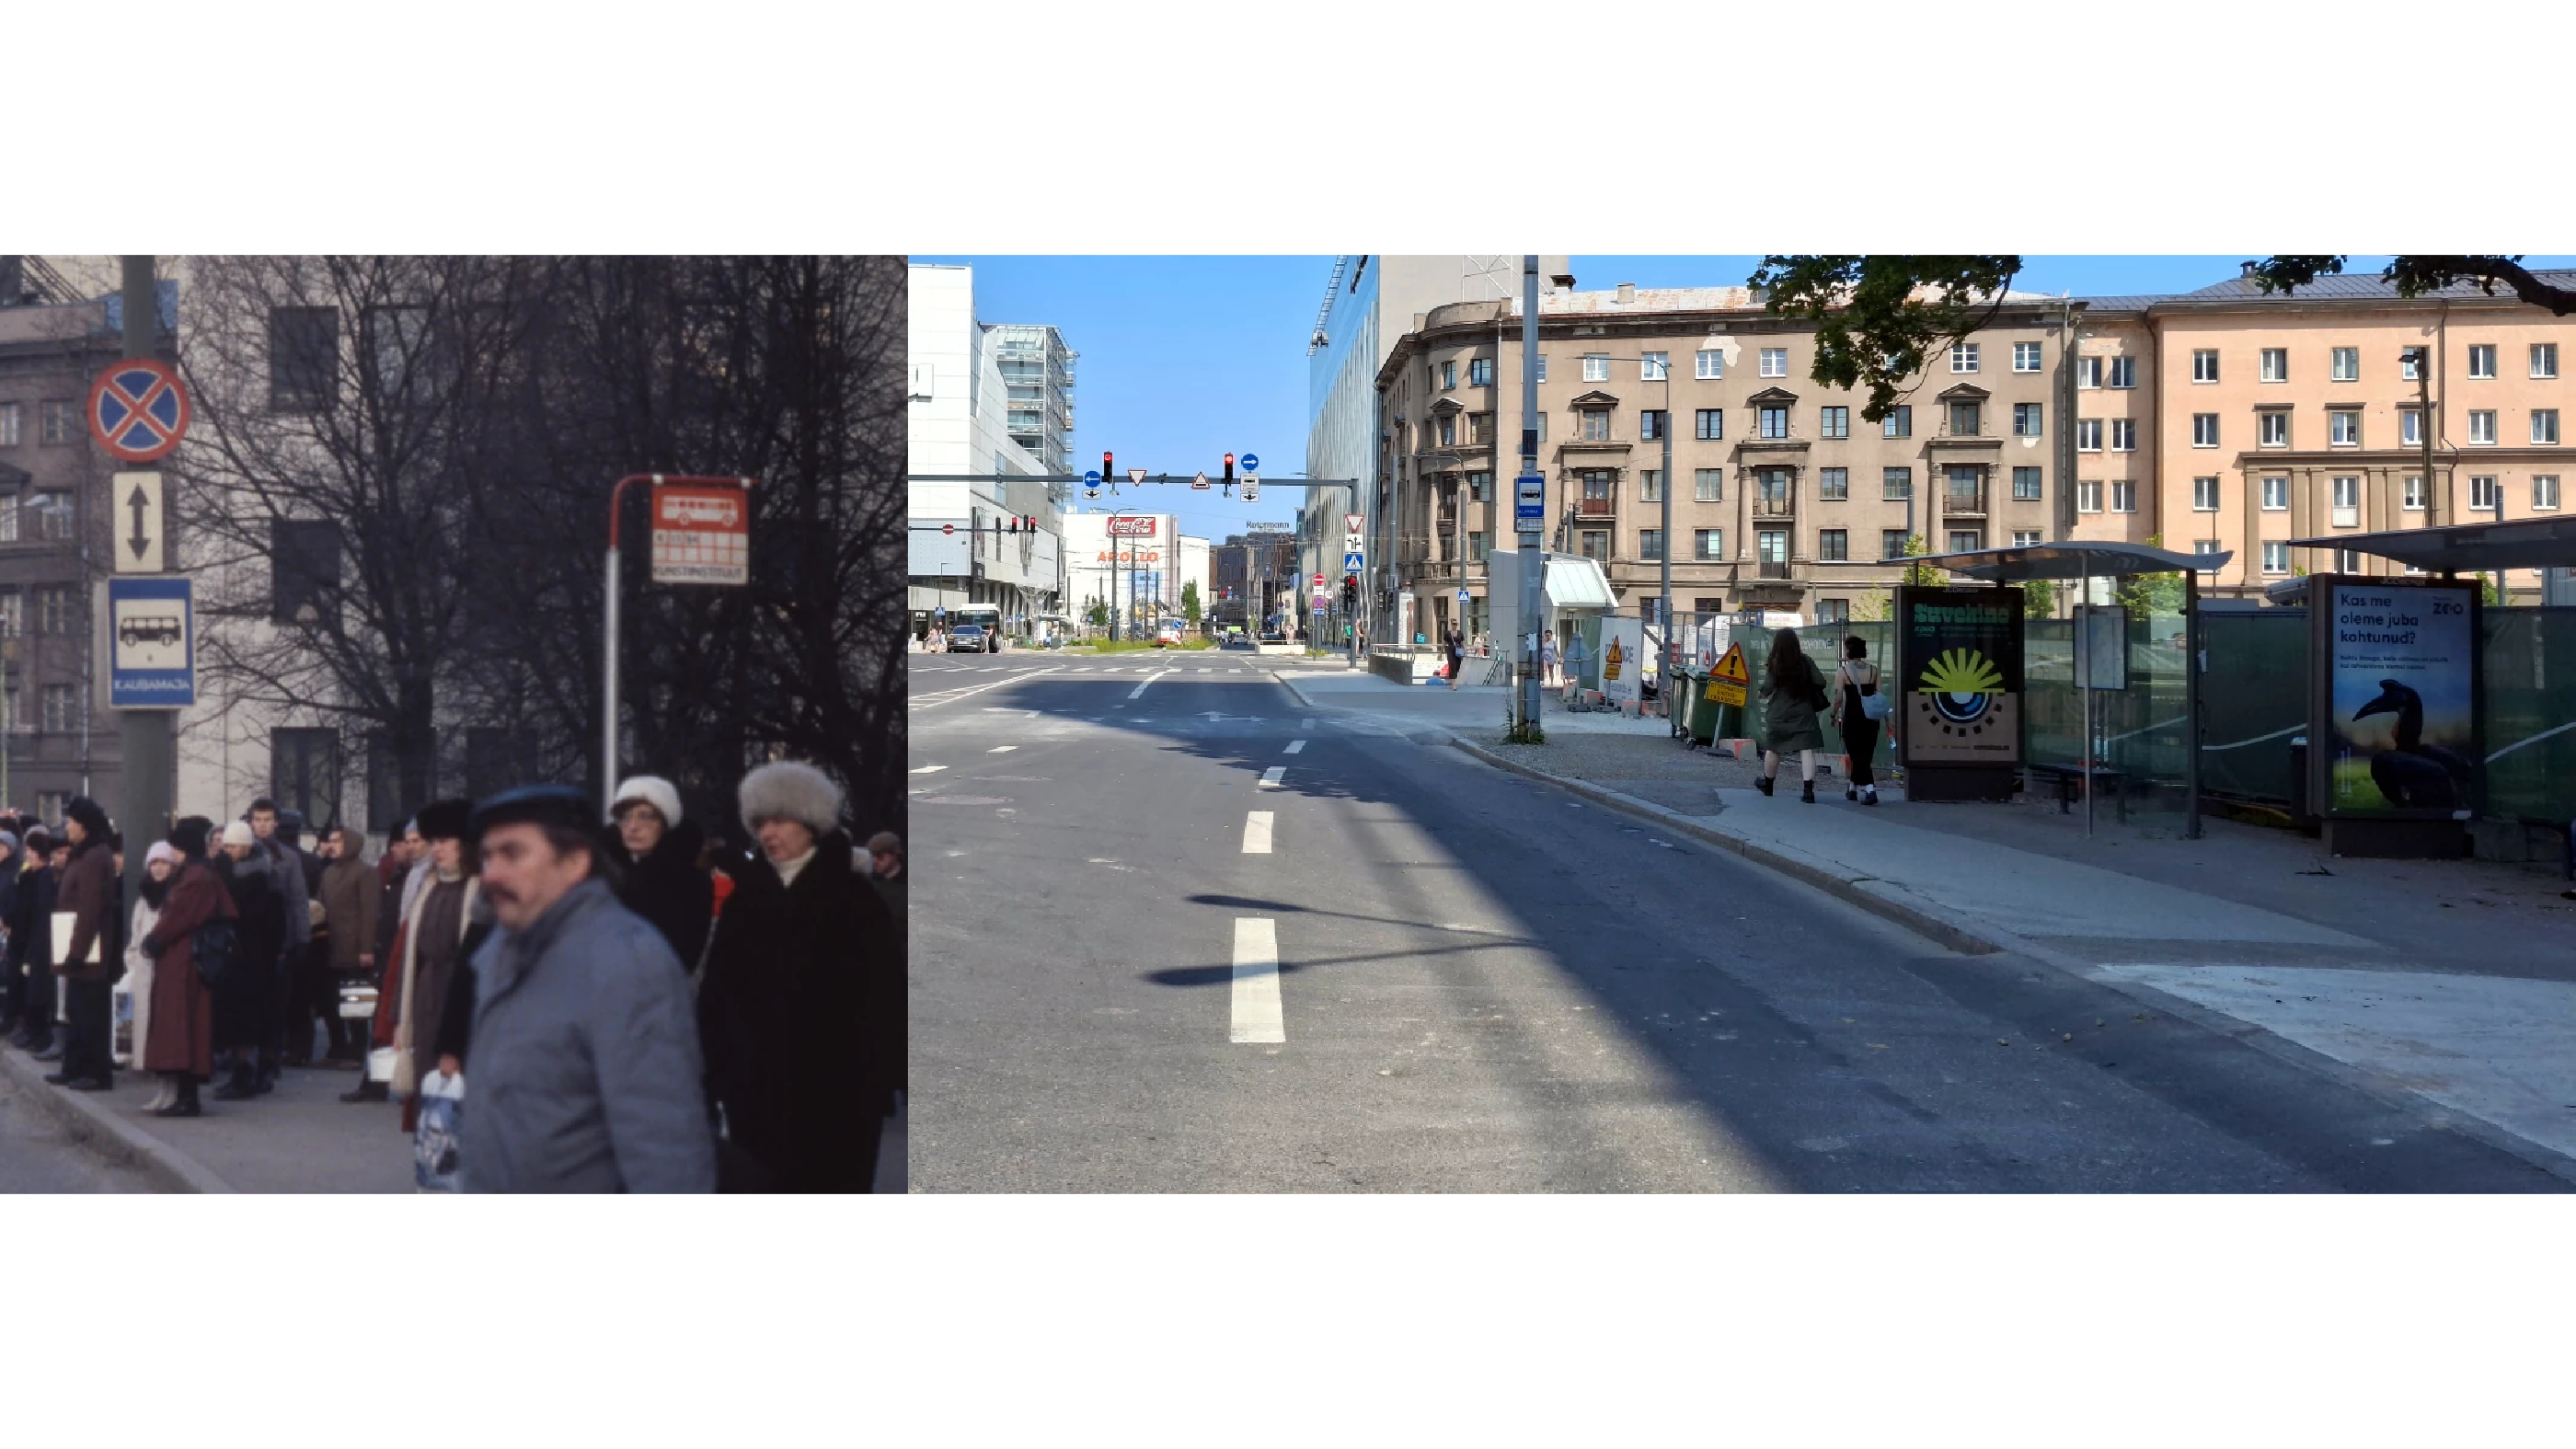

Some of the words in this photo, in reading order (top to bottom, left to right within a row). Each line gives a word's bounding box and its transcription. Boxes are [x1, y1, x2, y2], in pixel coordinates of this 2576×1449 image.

[1098, 551, 1158, 561] APOLO
[2340, 593, 2367, 607] Kas
[2370, 597, 2392, 607] me
[1915, 603, 2009, 623] Suvekino
[2340, 611, 2385, 626] oleme
[2386, 612, 2420, 627] juba
[2340, 629, 2417, 645] kohtunud?
[114, 678, 190, 690] KAUBAMAJA
